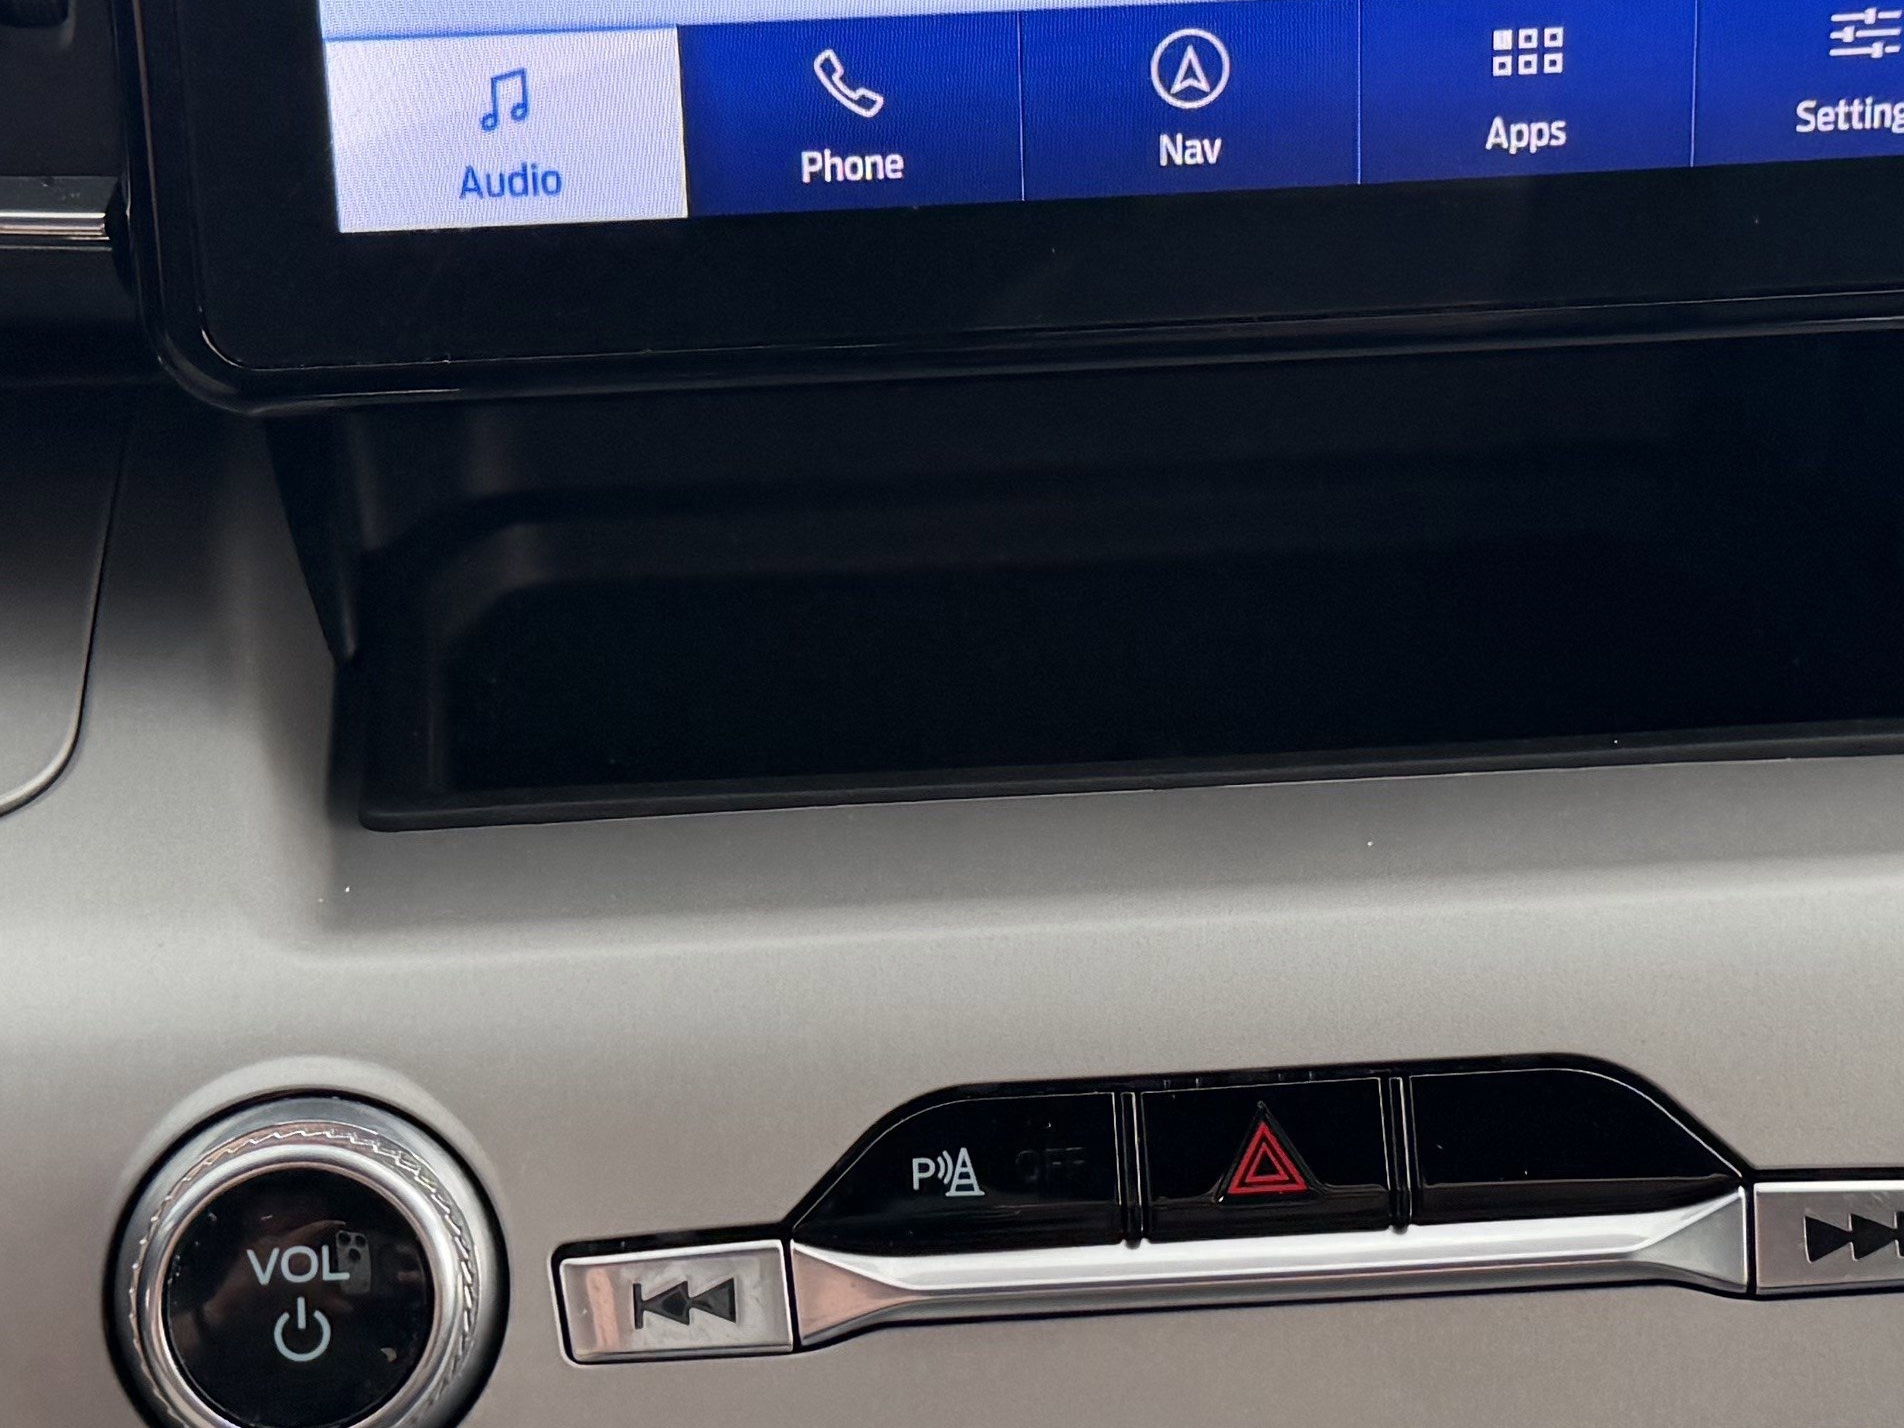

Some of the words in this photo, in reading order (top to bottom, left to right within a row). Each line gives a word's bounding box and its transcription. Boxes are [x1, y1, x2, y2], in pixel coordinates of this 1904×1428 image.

[1159, 132, 1222, 167] Nav
[1485, 116, 1567, 155] Apps
[460, 163, 563, 198] Audio
[801, 148, 904, 184] Phone
[246, 1245, 351, 1285] VOL
